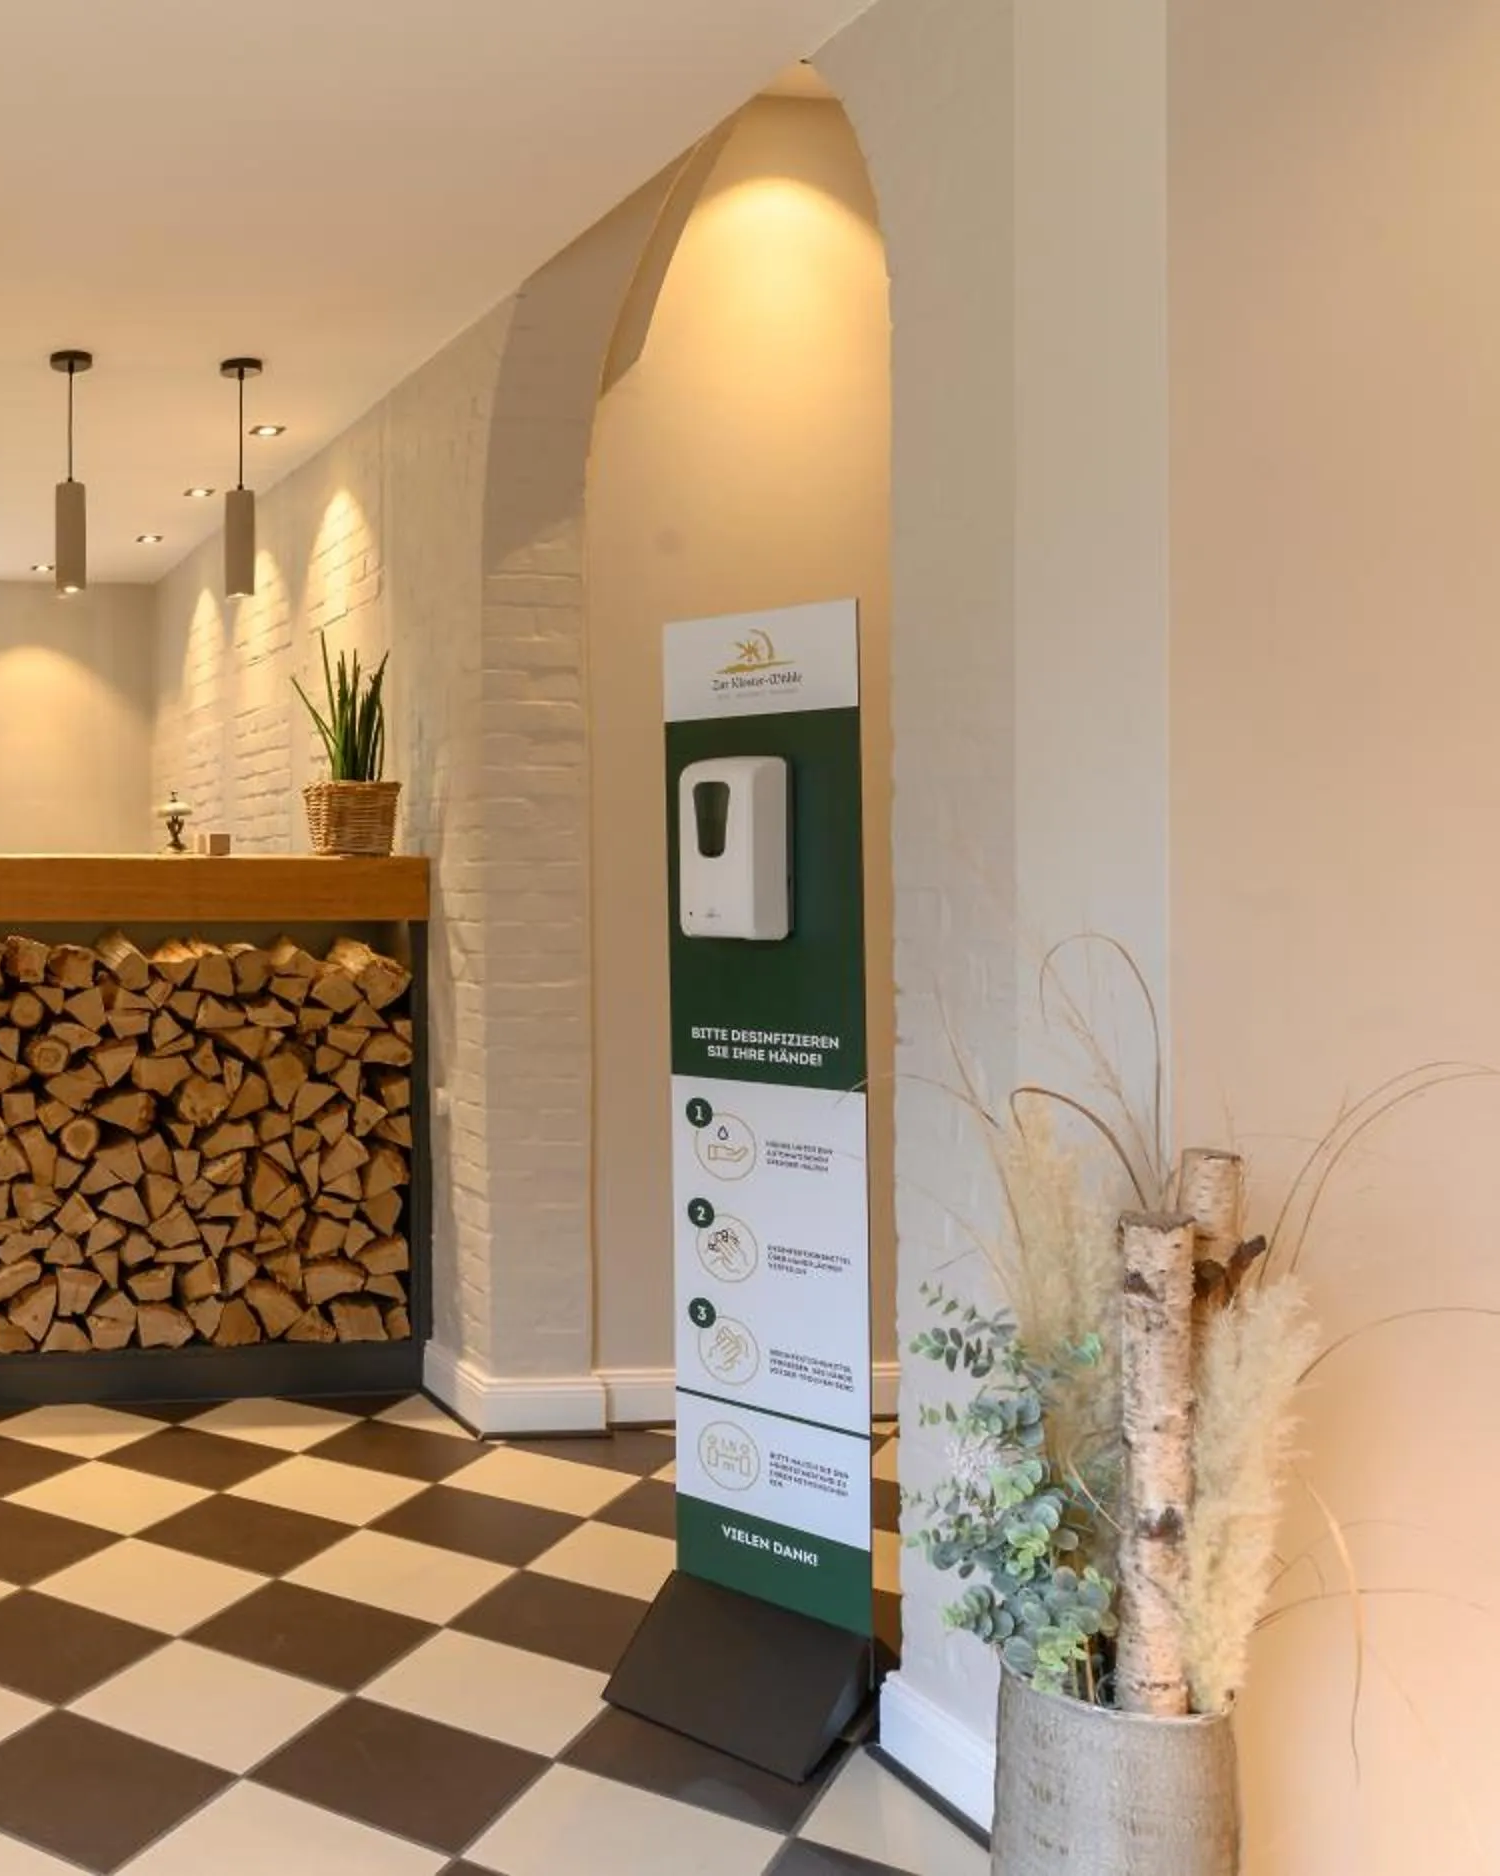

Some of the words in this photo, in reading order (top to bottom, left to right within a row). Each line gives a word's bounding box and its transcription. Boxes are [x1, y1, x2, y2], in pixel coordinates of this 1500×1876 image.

[691, 1026, 728, 1041] BITTE
[731, 1029, 839, 1049] DESINFIZIEREN
[707, 1045, 728, 1059] SIE
[733, 1047, 765, 1061] IHRE
[769, 1047, 823, 1067] HÄNDE!
[695, 1105, 703, 1122] 1
[696, 1205, 706, 1221] 2
[697, 1305, 707, 1321] 3
[721, 1524, 771, 1550] VIELEN
[773, 1541, 818, 1567] DANK!
